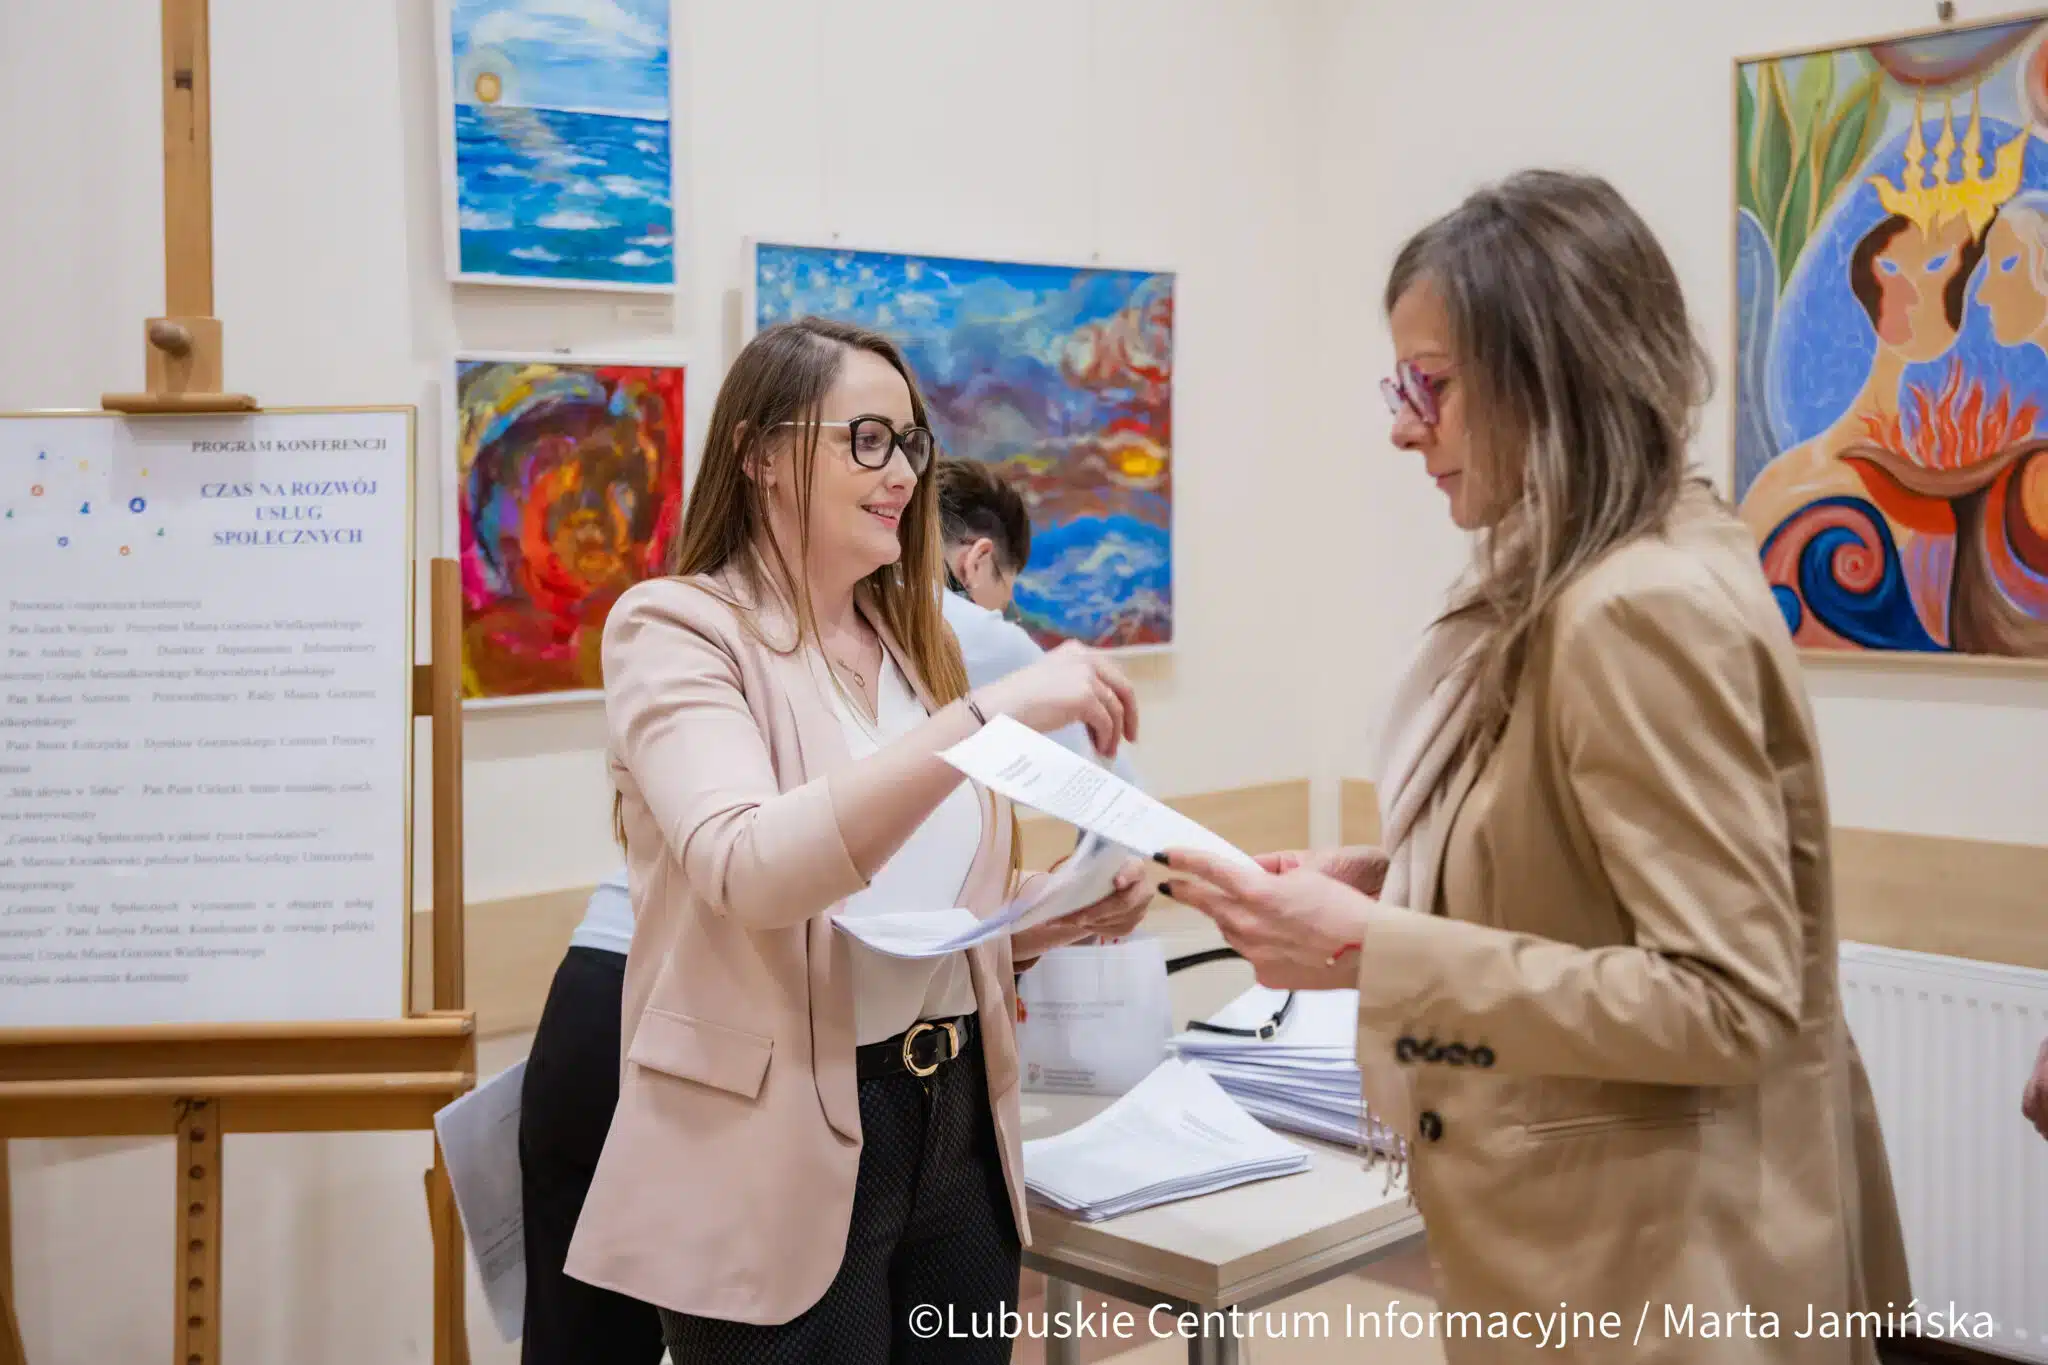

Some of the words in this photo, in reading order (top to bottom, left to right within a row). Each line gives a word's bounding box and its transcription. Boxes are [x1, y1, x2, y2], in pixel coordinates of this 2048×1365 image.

[192, 439, 272, 453] PROGRAM
[277, 437, 388, 451] KONFERENCJI
[201, 482, 253, 498] CZAS
[260, 482, 286, 497] NA
[291, 476, 377, 496] ROZWÓJ
